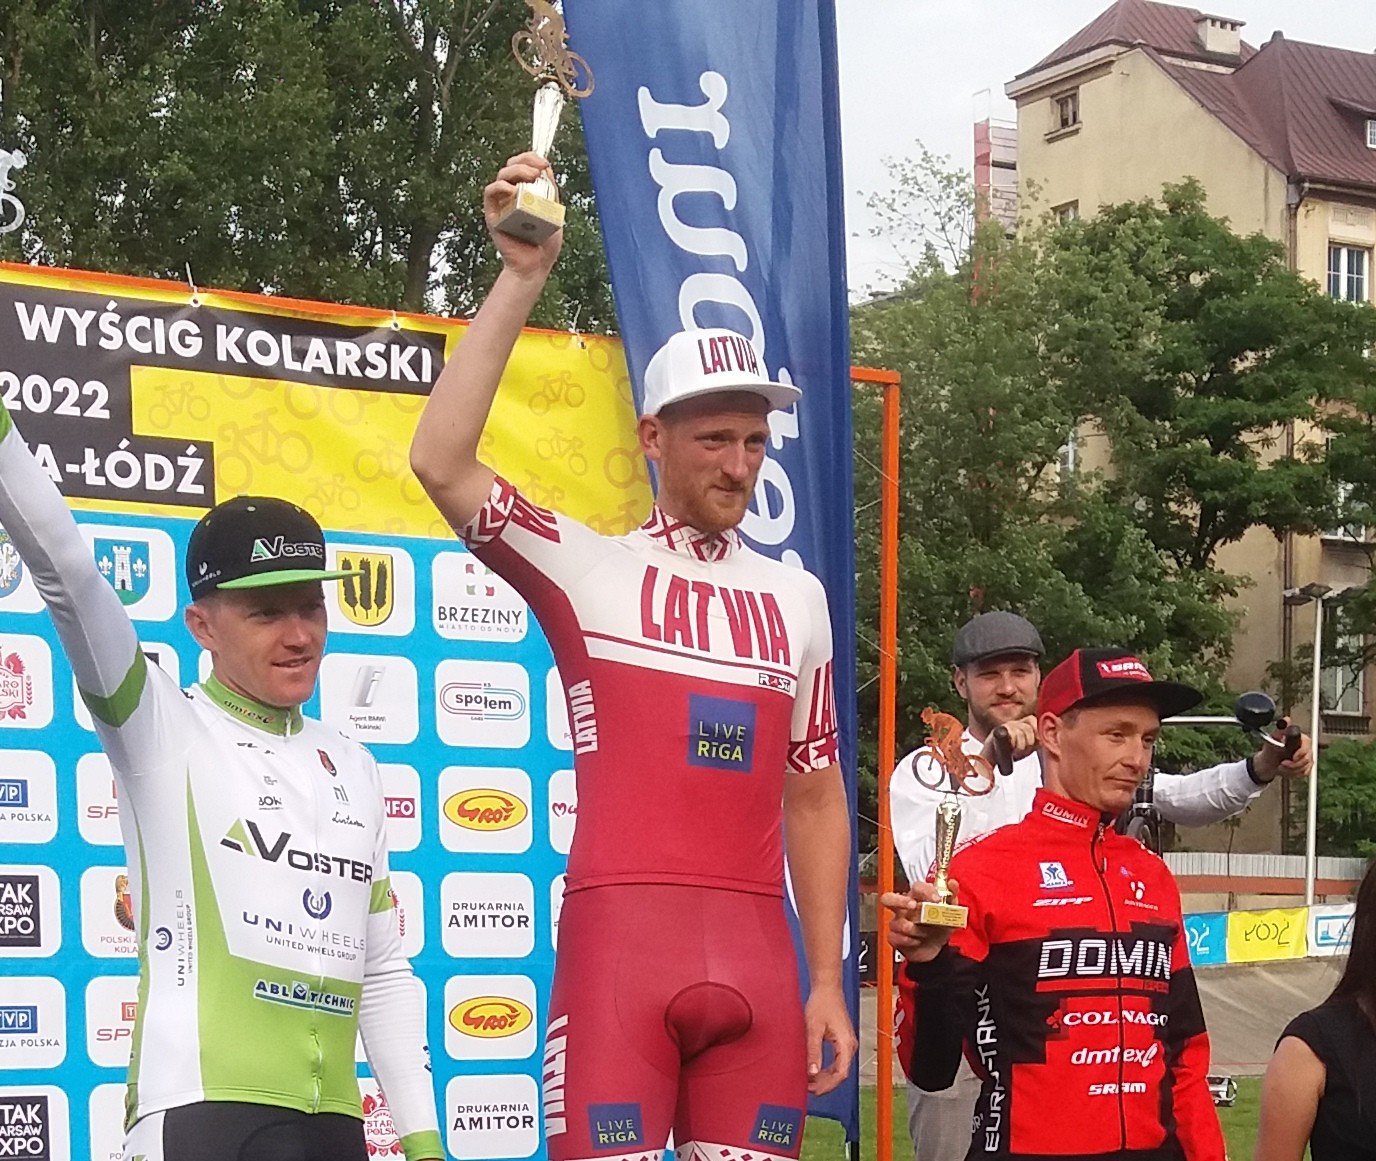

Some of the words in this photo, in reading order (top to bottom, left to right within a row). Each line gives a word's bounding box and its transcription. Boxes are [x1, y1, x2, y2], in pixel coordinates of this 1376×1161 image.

[15, 300, 204, 358] WYŚCIG
[216, 324, 433, 383] KOLARSKI
[697, 336, 760, 377] LATVIA
[437, 606, 523, 625] BRZEZINY
[641, 565, 791, 667] LATVIA
[455, 692, 512, 711] społem
[570, 679, 599, 755] LATVIA
[698, 725, 747, 742] LIVE
[11, 813, 52, 822] POLSKA
[1042, 801, 1091, 826] DOMIN
[452, 902, 525, 912] DRUKARNIA
[1032, 896, 1094, 907] ZIPP
[447, 914, 531, 928] AMITOR
[242, 911, 366, 950] UNIWHEELS
[1037, 938, 1173, 981] DOMIN
[255, 980, 290, 998] ABL
[1063, 1009, 1169, 1027] COLNAGO
[21, 1037, 61, 1047] POLSKA
[457, 1103, 530, 1114] DRUKARNIA
[452, 1115, 535, 1131] AMITOR
[596, 1118, 635, 1133] LIVE
[760, 1119, 794, 1135] LIVE
